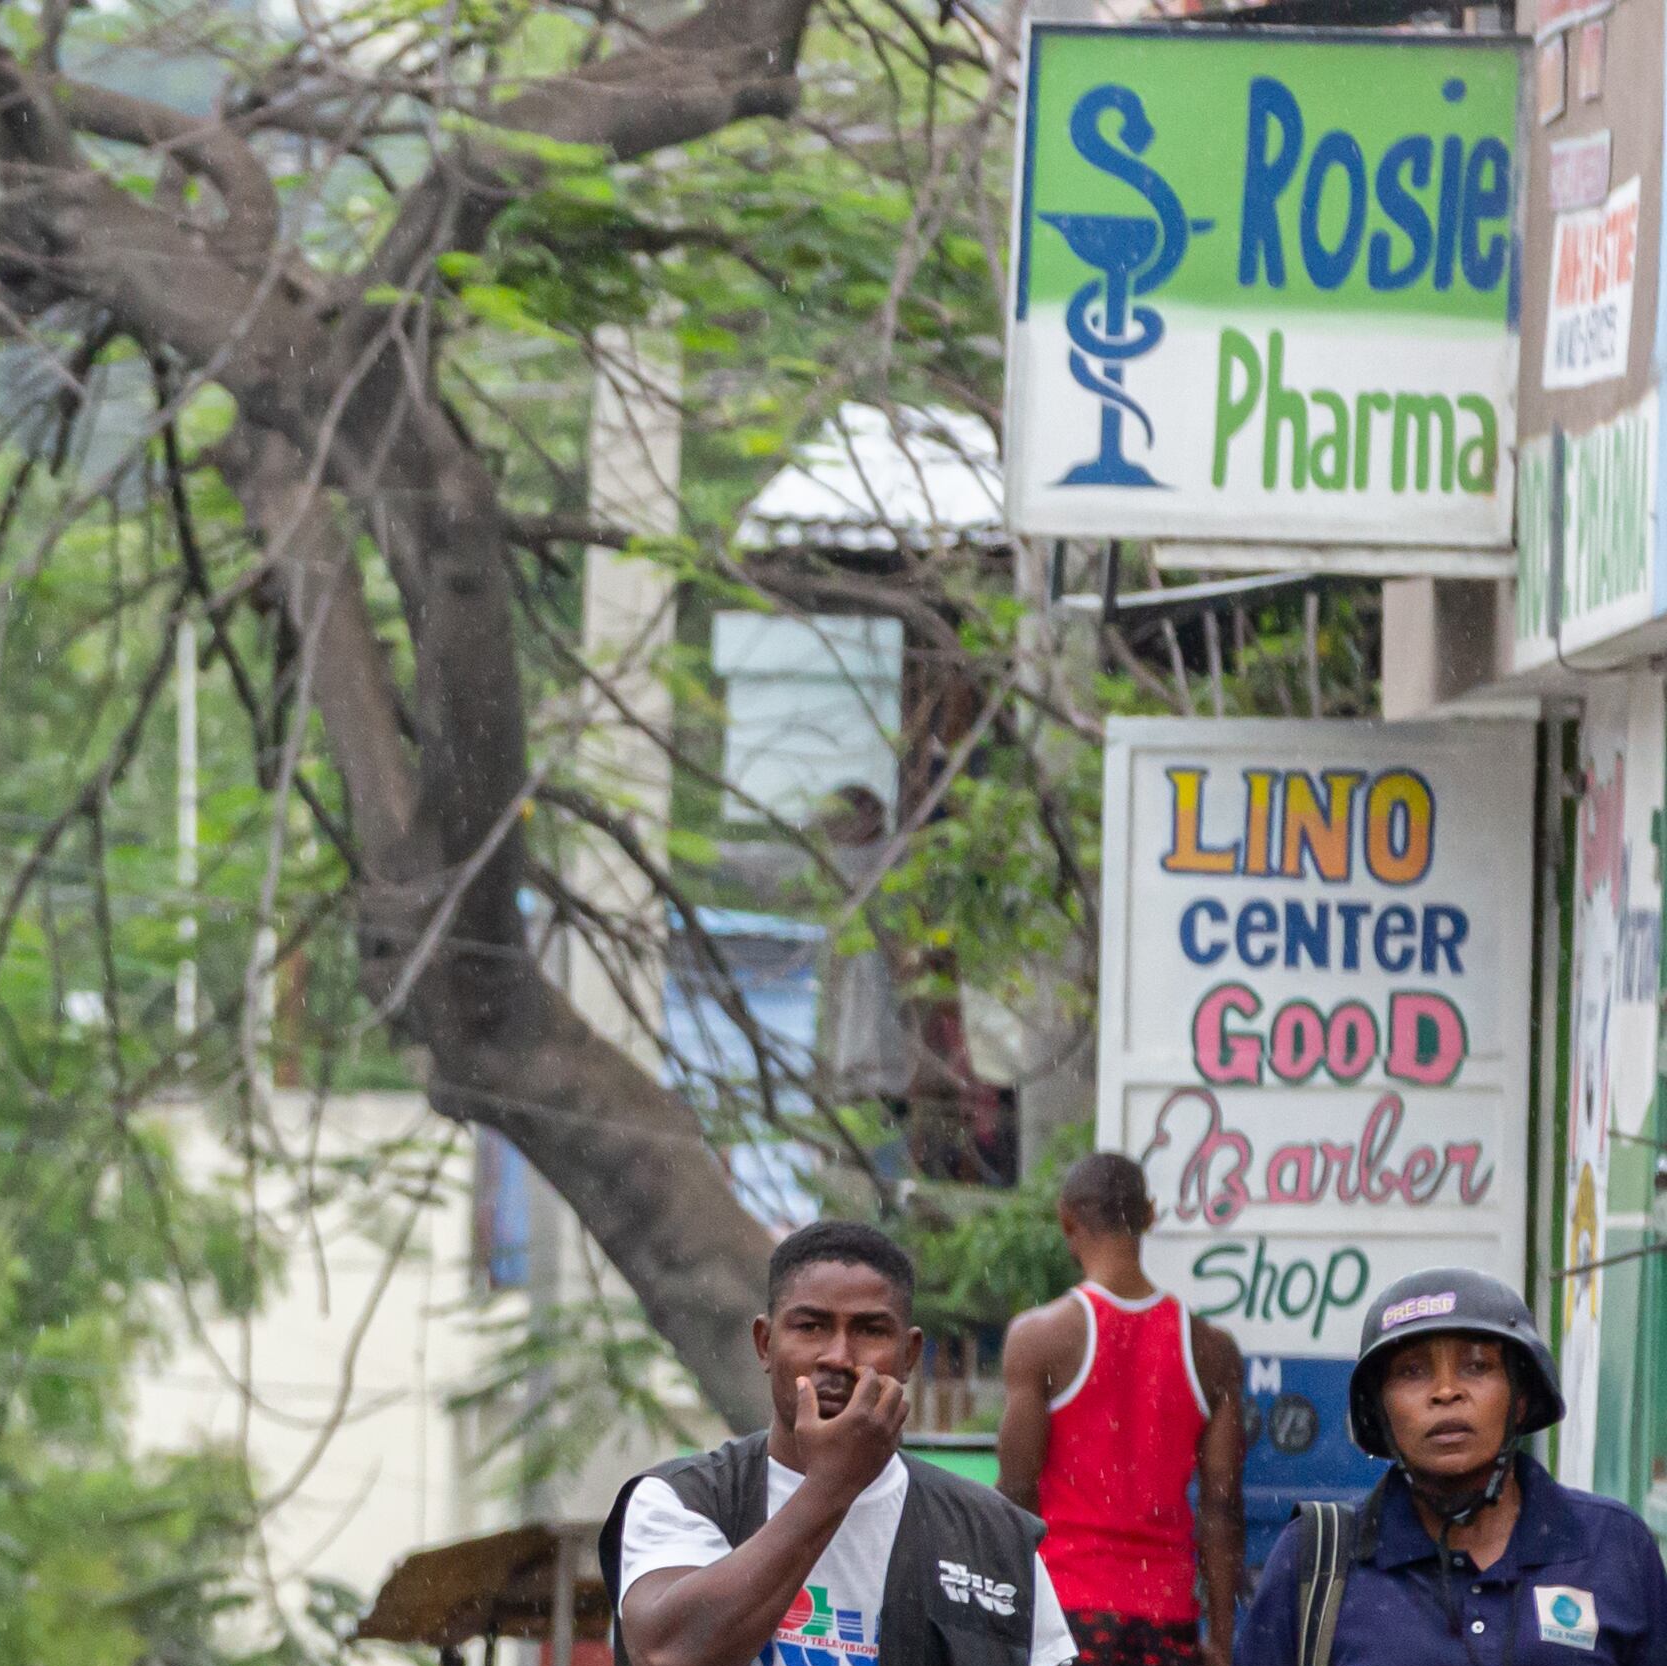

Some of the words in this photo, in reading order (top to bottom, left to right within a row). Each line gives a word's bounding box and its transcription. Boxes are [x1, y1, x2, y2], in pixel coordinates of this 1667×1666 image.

[1238, 75, 1511, 293] Rosie
[1210, 325, 1499, 494] Pharma
[1160, 766, 1436, 886] LINO
[1191, 982, 1469, 1087] GOOD
[1143, 1086, 1495, 1226] Barber
[1190, 1236, 1369, 1340] Shop
[775, 1629, 807, 1645] RADIO
[810, 1637, 878, 1656] TELEVISION
